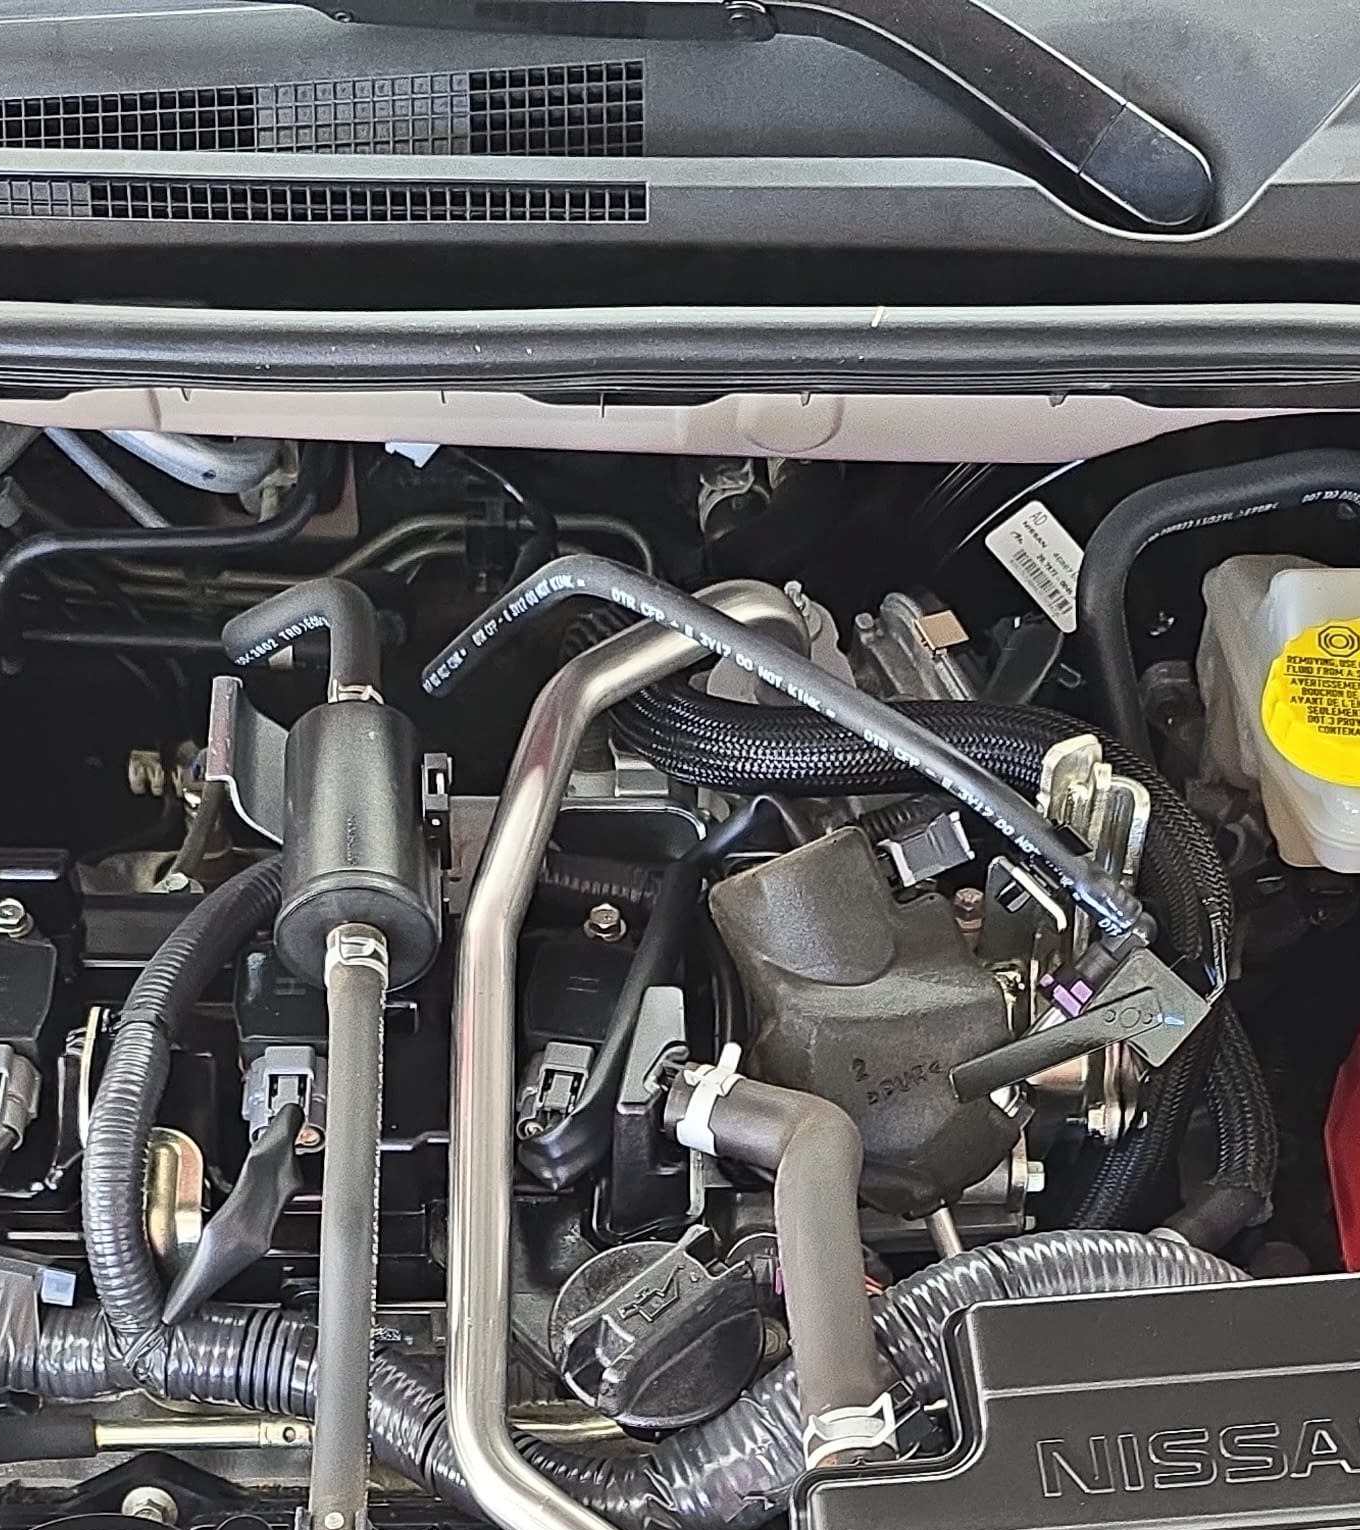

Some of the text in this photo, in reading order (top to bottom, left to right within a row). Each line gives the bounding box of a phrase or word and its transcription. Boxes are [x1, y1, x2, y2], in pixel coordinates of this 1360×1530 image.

[1339, 660, 1357, 668] USE
[1287, 665, 1314, 674] FLUID
[1317, 666, 1343, 676] FROM
[758, 666, 783, 689] NOT
[787, 683, 820, 712] KINK
[1301, 687, 1345, 697] BOUCHON
[1346, 691, 1359, 699] DE
[1290, 696, 1323, 705] AVANT
[1326, 698, 1339, 707] DE
[1307, 715, 1325, 724] DOT
[993, 817, 1014, 837] DO
